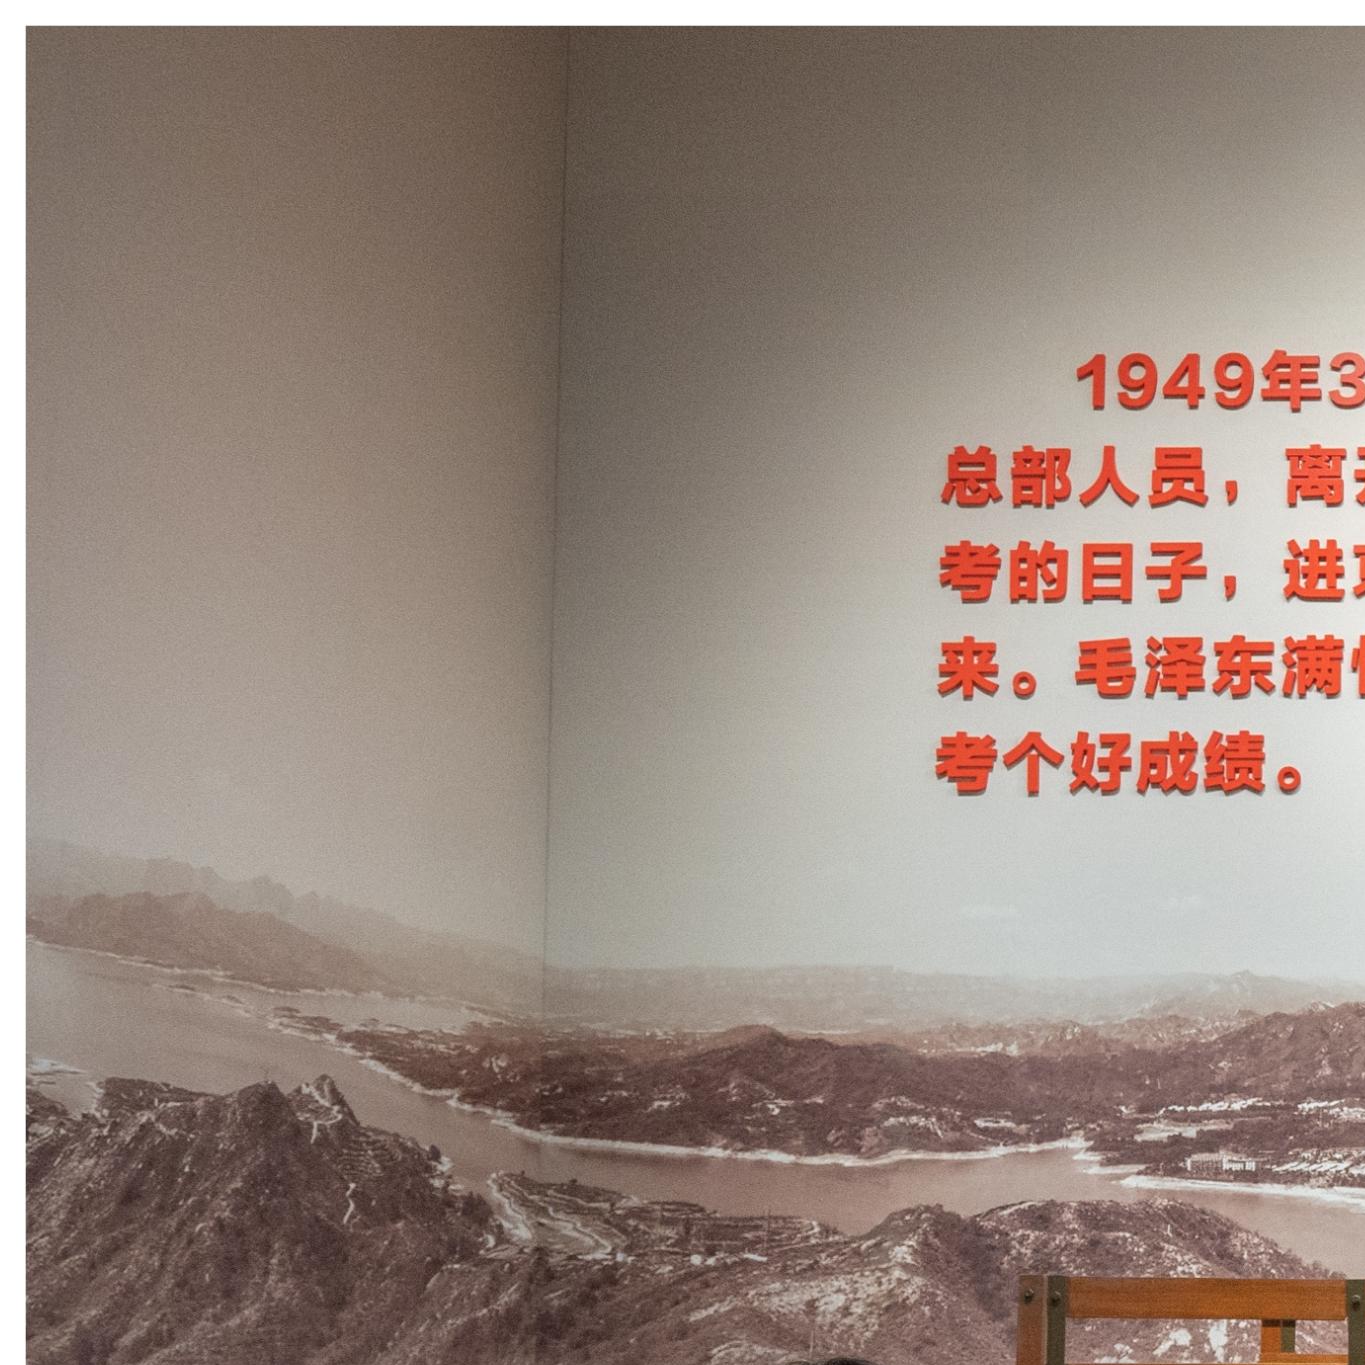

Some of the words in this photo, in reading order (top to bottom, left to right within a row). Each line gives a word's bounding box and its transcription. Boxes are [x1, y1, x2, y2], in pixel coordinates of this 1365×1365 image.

[934, 730, 1302, 795] 考个好成绩。
